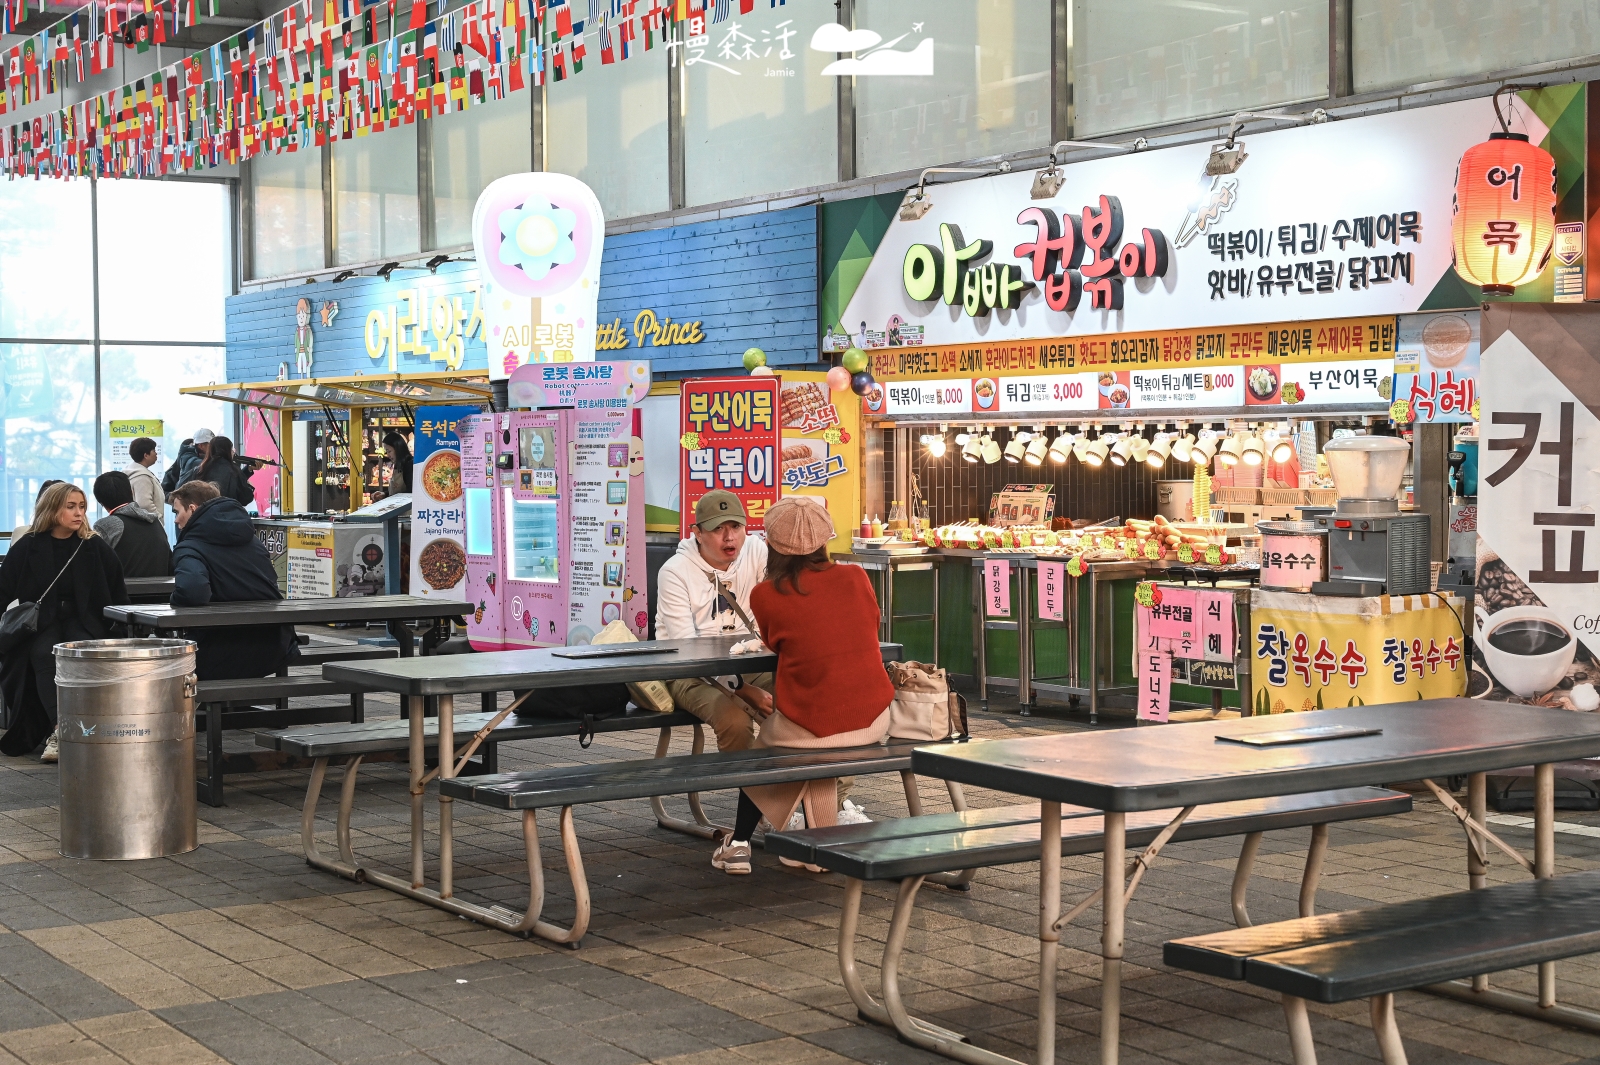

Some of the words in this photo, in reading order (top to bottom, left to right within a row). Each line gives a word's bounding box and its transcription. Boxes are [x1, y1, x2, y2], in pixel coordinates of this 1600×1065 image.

[1483, 165, 1522, 254] 어묵
[1332, 211, 1422, 249] 수제어묵
[634, 309, 705, 347] Prince
[875, 354, 896, 376] 츄러스
[899, 352, 938, 375] 마약핫도그
[941, 350, 957, 372] 소떡
[959, 349, 983, 371] 소세지
[985, 346, 1036, 371] 후라이드치킨
[1039, 343, 1075, 368] 새우튀김
[1080, 341, 1108, 366] 핫도그
[1110, 337, 1159, 364] 회오리감자
[1163, 335, 1192, 362] 닭강정
[1230, 331, 1263, 358] 군만두
[1267, 328, 1312, 356] 매운어묵
[1316, 325, 1364, 354] 수제어묵
[1368, 323, 1394, 352] 김밥
[542, 366, 569, 381] 로봇
[572, 365, 613, 380] 솜사탕
[1053, 382, 1083, 401] 3,000
[1309, 368, 1378, 390] 부산어묵
[890, 387, 921, 406] 떡볶이
[1006, 383, 1031, 402] 튀김
[1032, 383, 1047, 393] 1인분
[1409, 371, 1476, 421] 식혜
[112, 424, 146, 434] 어린왕자
[688, 390, 773, 433] 부산어묵
[800, 403, 840, 434] 소떡
[687, 446, 774, 488] 떡볶이
[785, 455, 849, 491] 핫도그
[417, 508, 464, 527] 짜장라
[719, 501, 728, 511] C
[424, 527, 442, 535] Jajang
[1046, 567, 1055, 612] 군만두
[1151, 604, 1193, 622] 유부전골
[1207, 600, 1222, 654] 식혜
[1257, 624, 1367, 687] 찰옥수수
[1382, 637, 1462, 684] 찰옥수수
[1149, 655, 1161, 716] 도너츠
